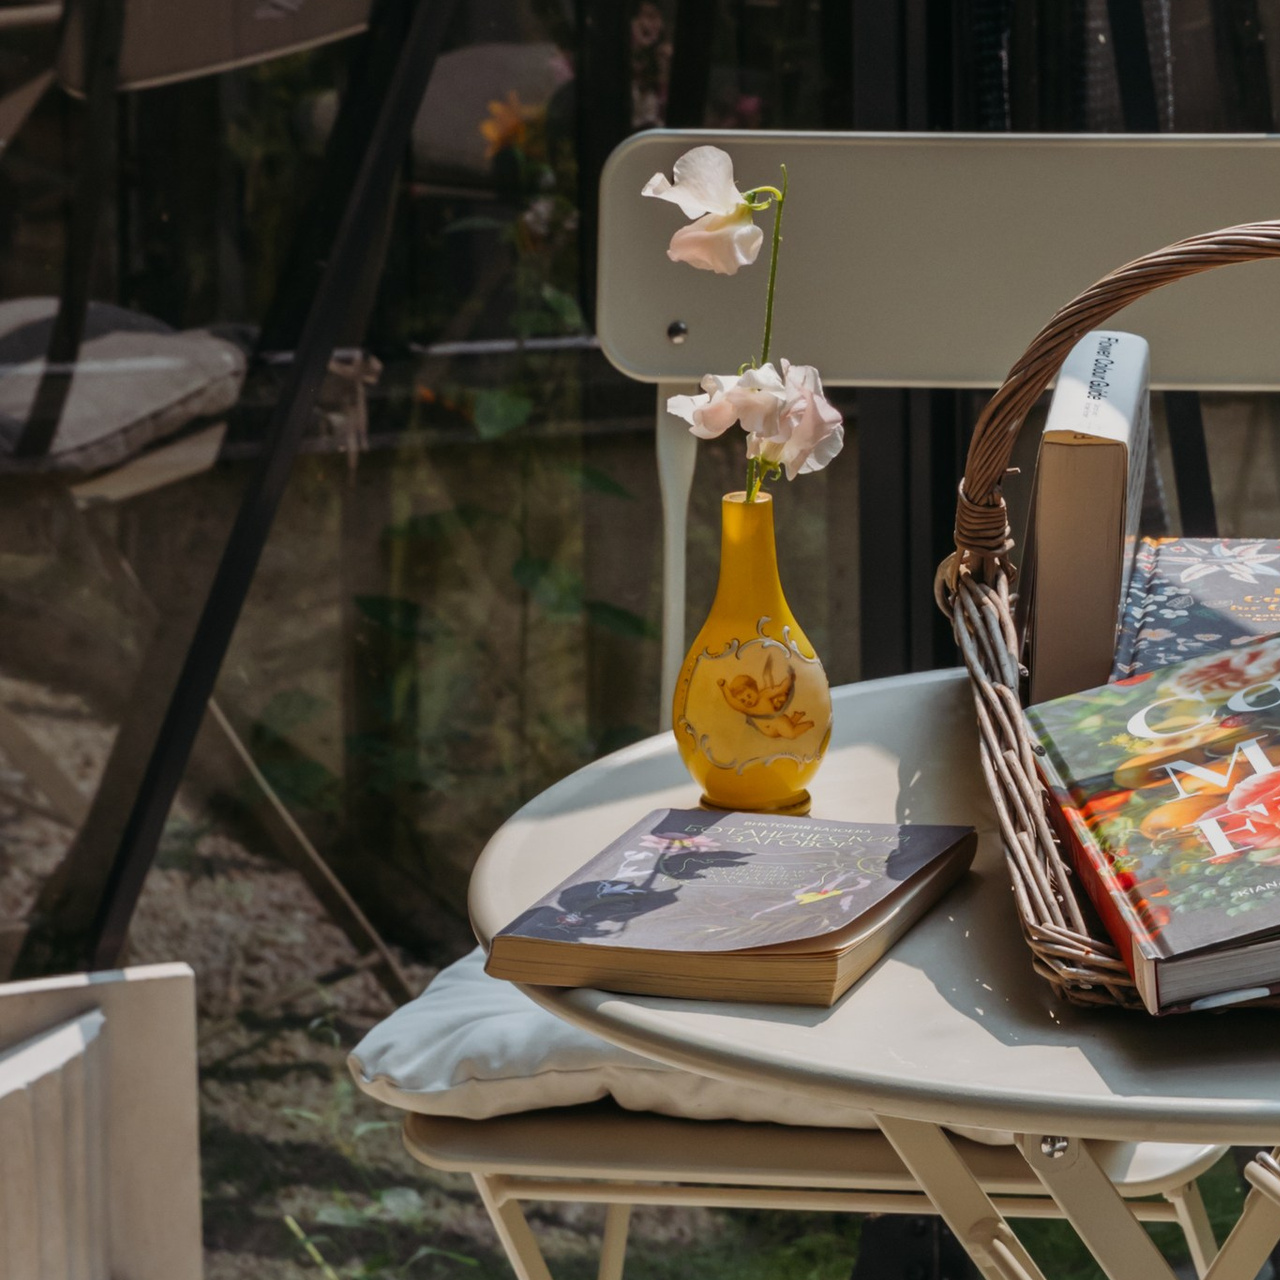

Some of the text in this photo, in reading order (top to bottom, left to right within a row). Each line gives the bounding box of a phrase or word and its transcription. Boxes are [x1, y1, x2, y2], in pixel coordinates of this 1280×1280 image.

[1097, 336, 1119, 358] Flower
[1092, 358, 1115, 380] Colour
[1087, 380, 1110, 400] Guide
[743, 821, 811, 831] ВИКТОРИЯ
[726, 835, 855, 849] ЗАГОВОР
